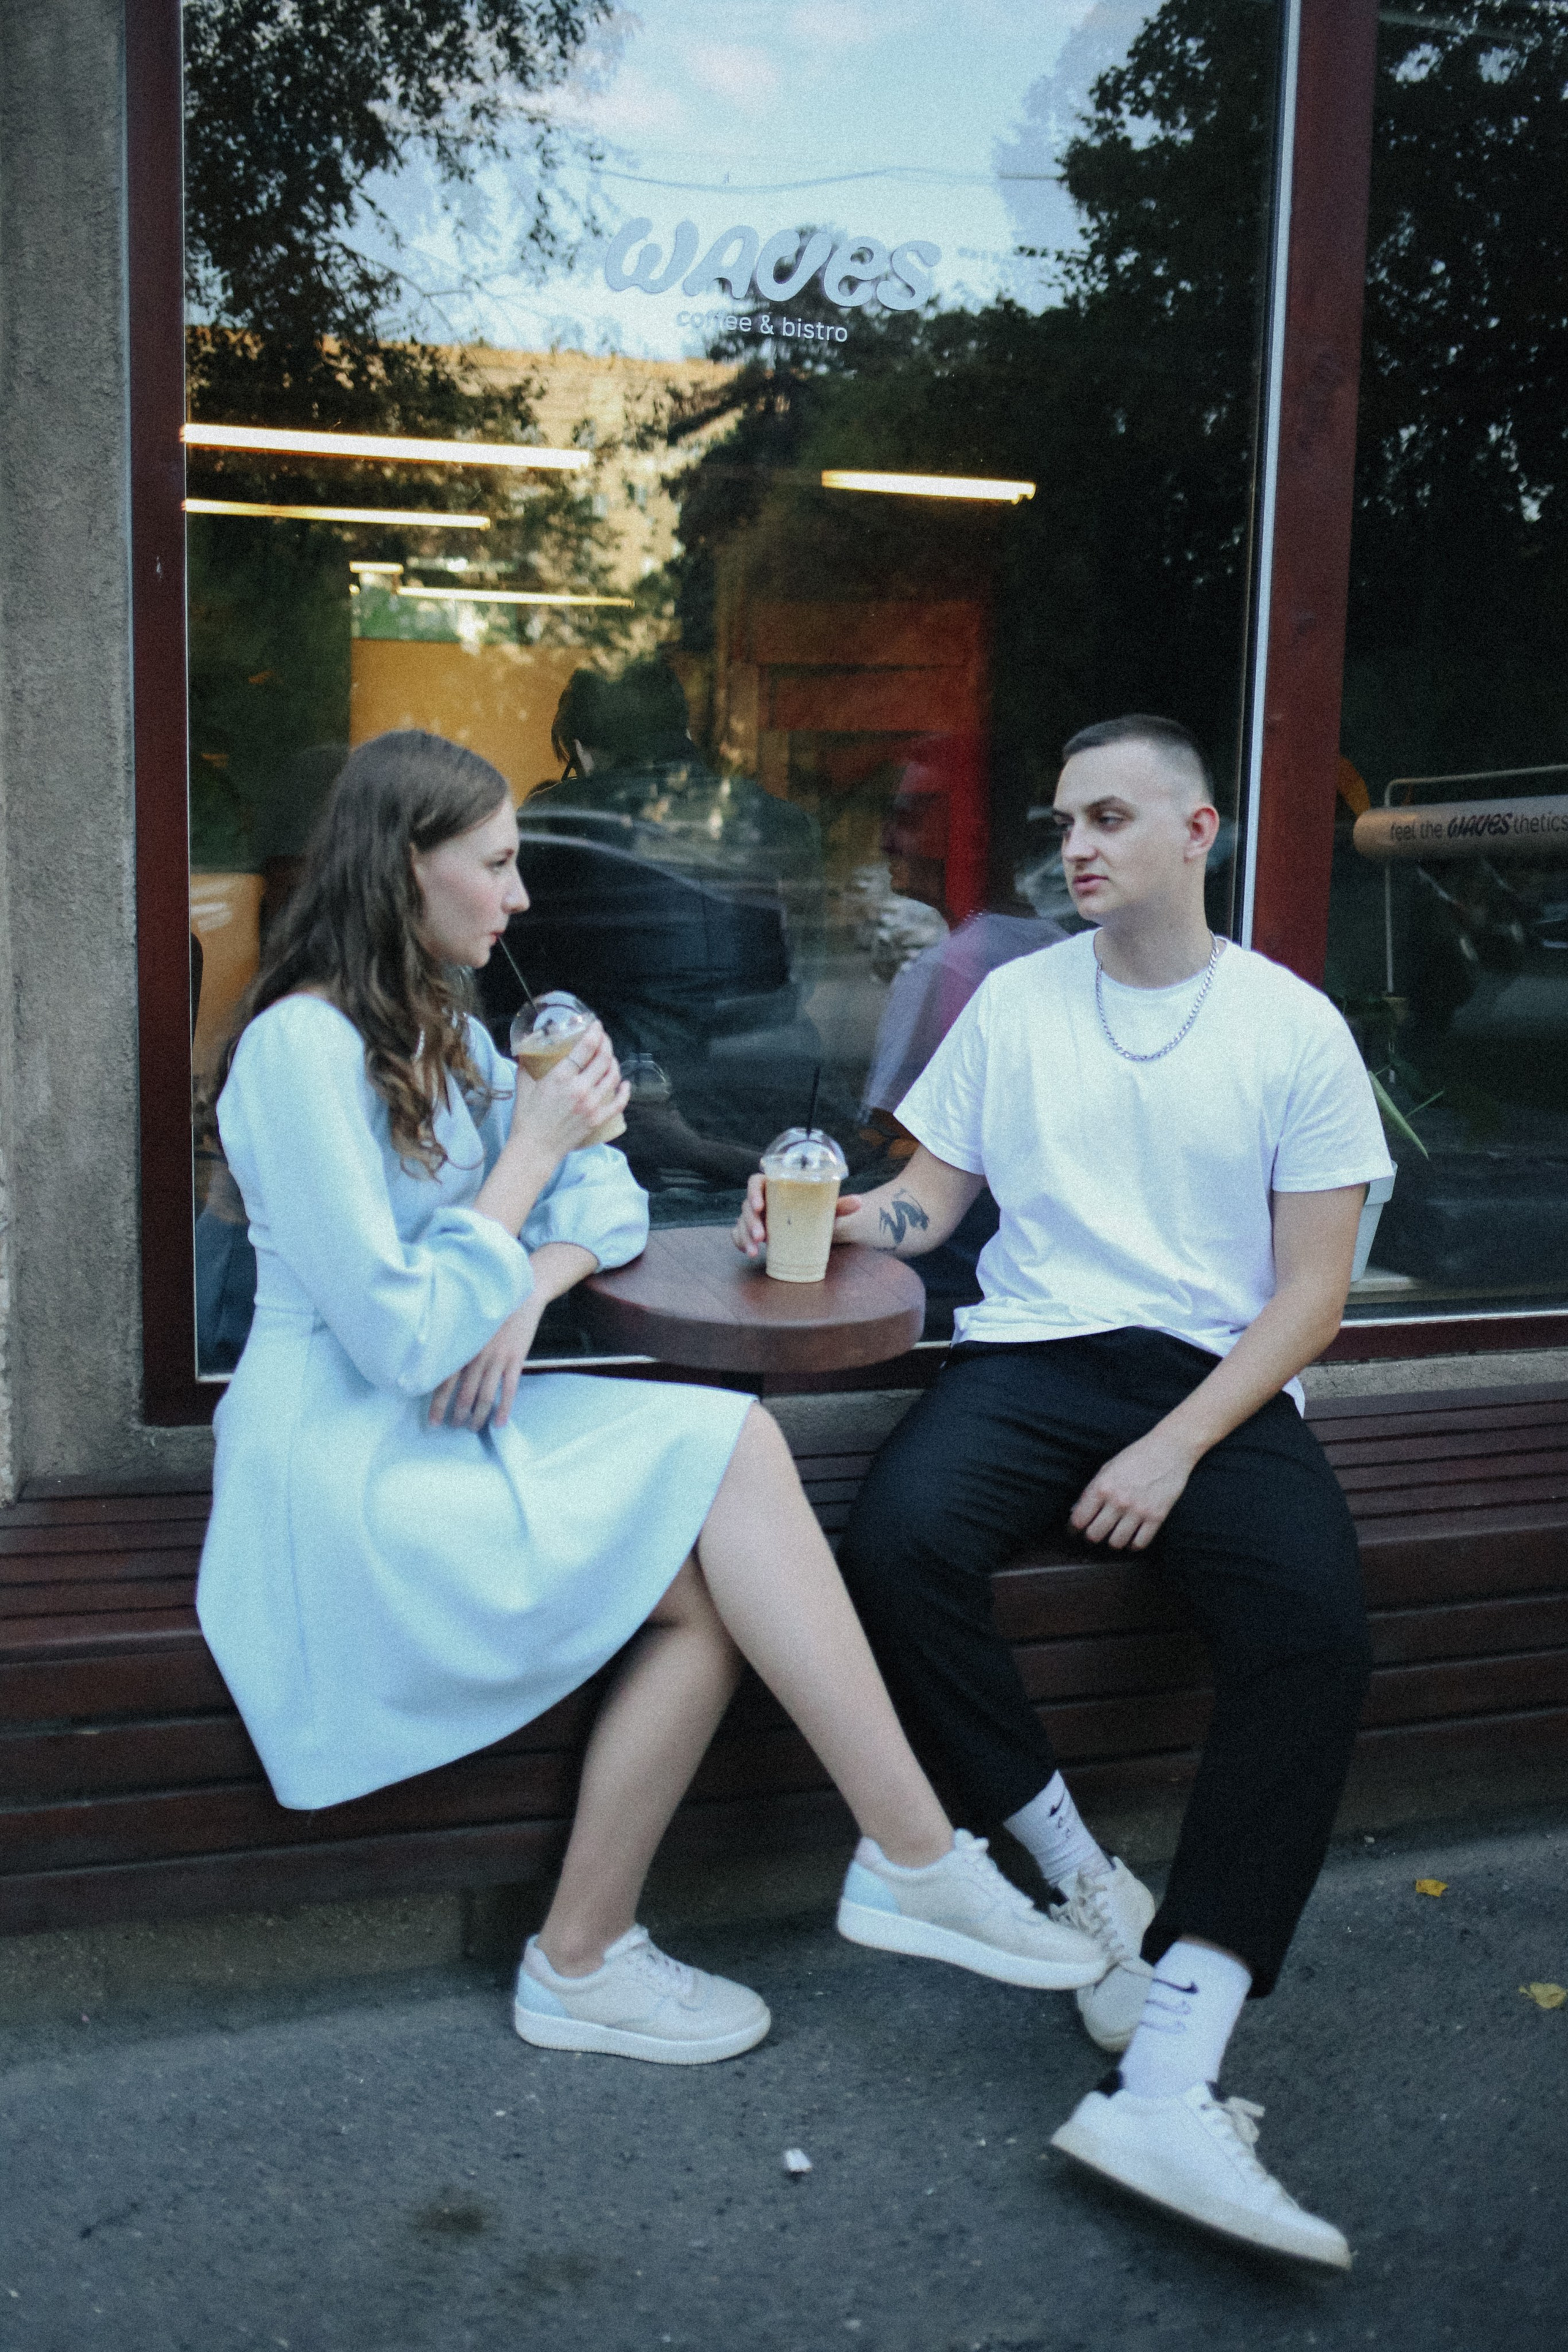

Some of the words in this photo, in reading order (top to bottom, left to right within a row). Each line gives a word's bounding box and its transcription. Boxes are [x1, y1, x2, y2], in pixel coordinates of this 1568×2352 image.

[676, 309, 752, 333] coffee
[760, 314, 774, 335] &
[782, 317, 848, 342] bistro
[1390, 821, 1415, 841] feel
[1420, 820, 1442, 839] the
